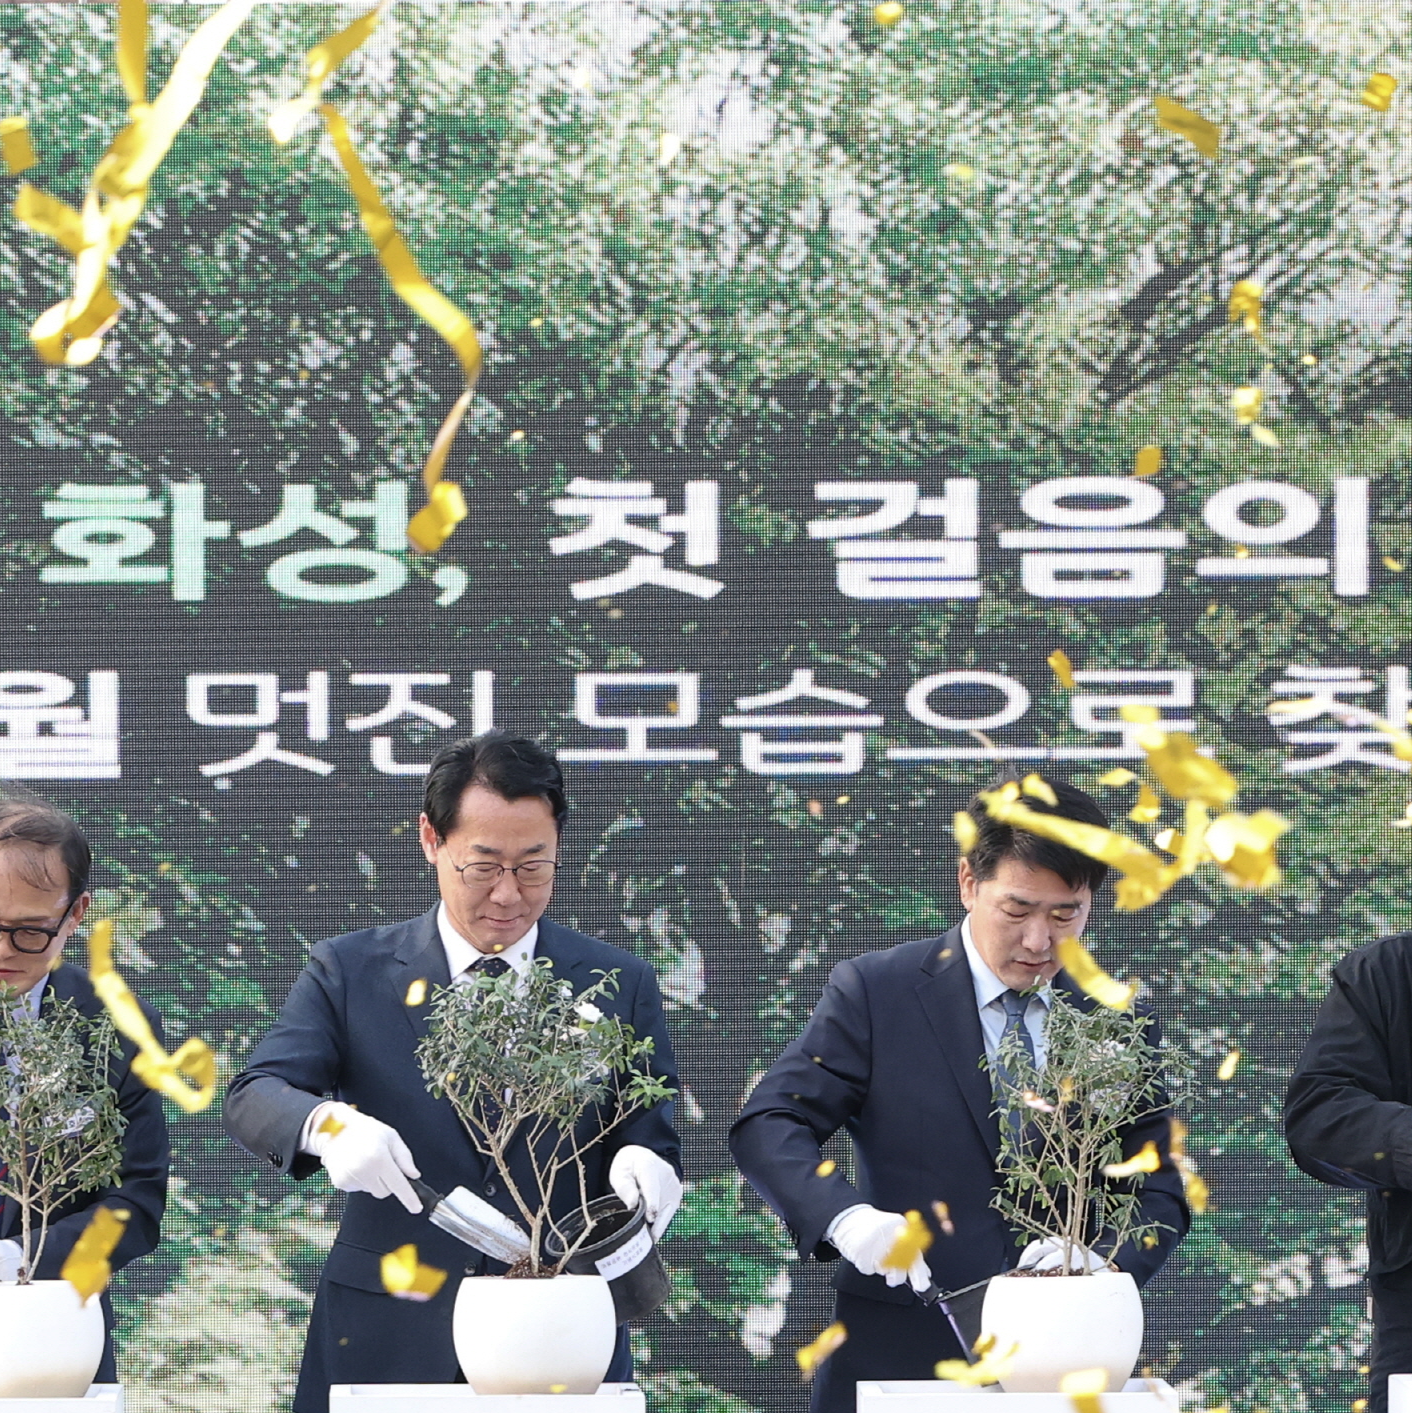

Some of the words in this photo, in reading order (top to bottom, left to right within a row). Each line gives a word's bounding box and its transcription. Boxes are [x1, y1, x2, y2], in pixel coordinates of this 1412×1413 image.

[39, 480, 468, 606] 화성,
[550, 477, 724, 600] 첫
[807, 475, 1370, 599] 걸음의
[187, 668, 494, 778] 멋진
[555, 667, 1215, 777] 모습으로
